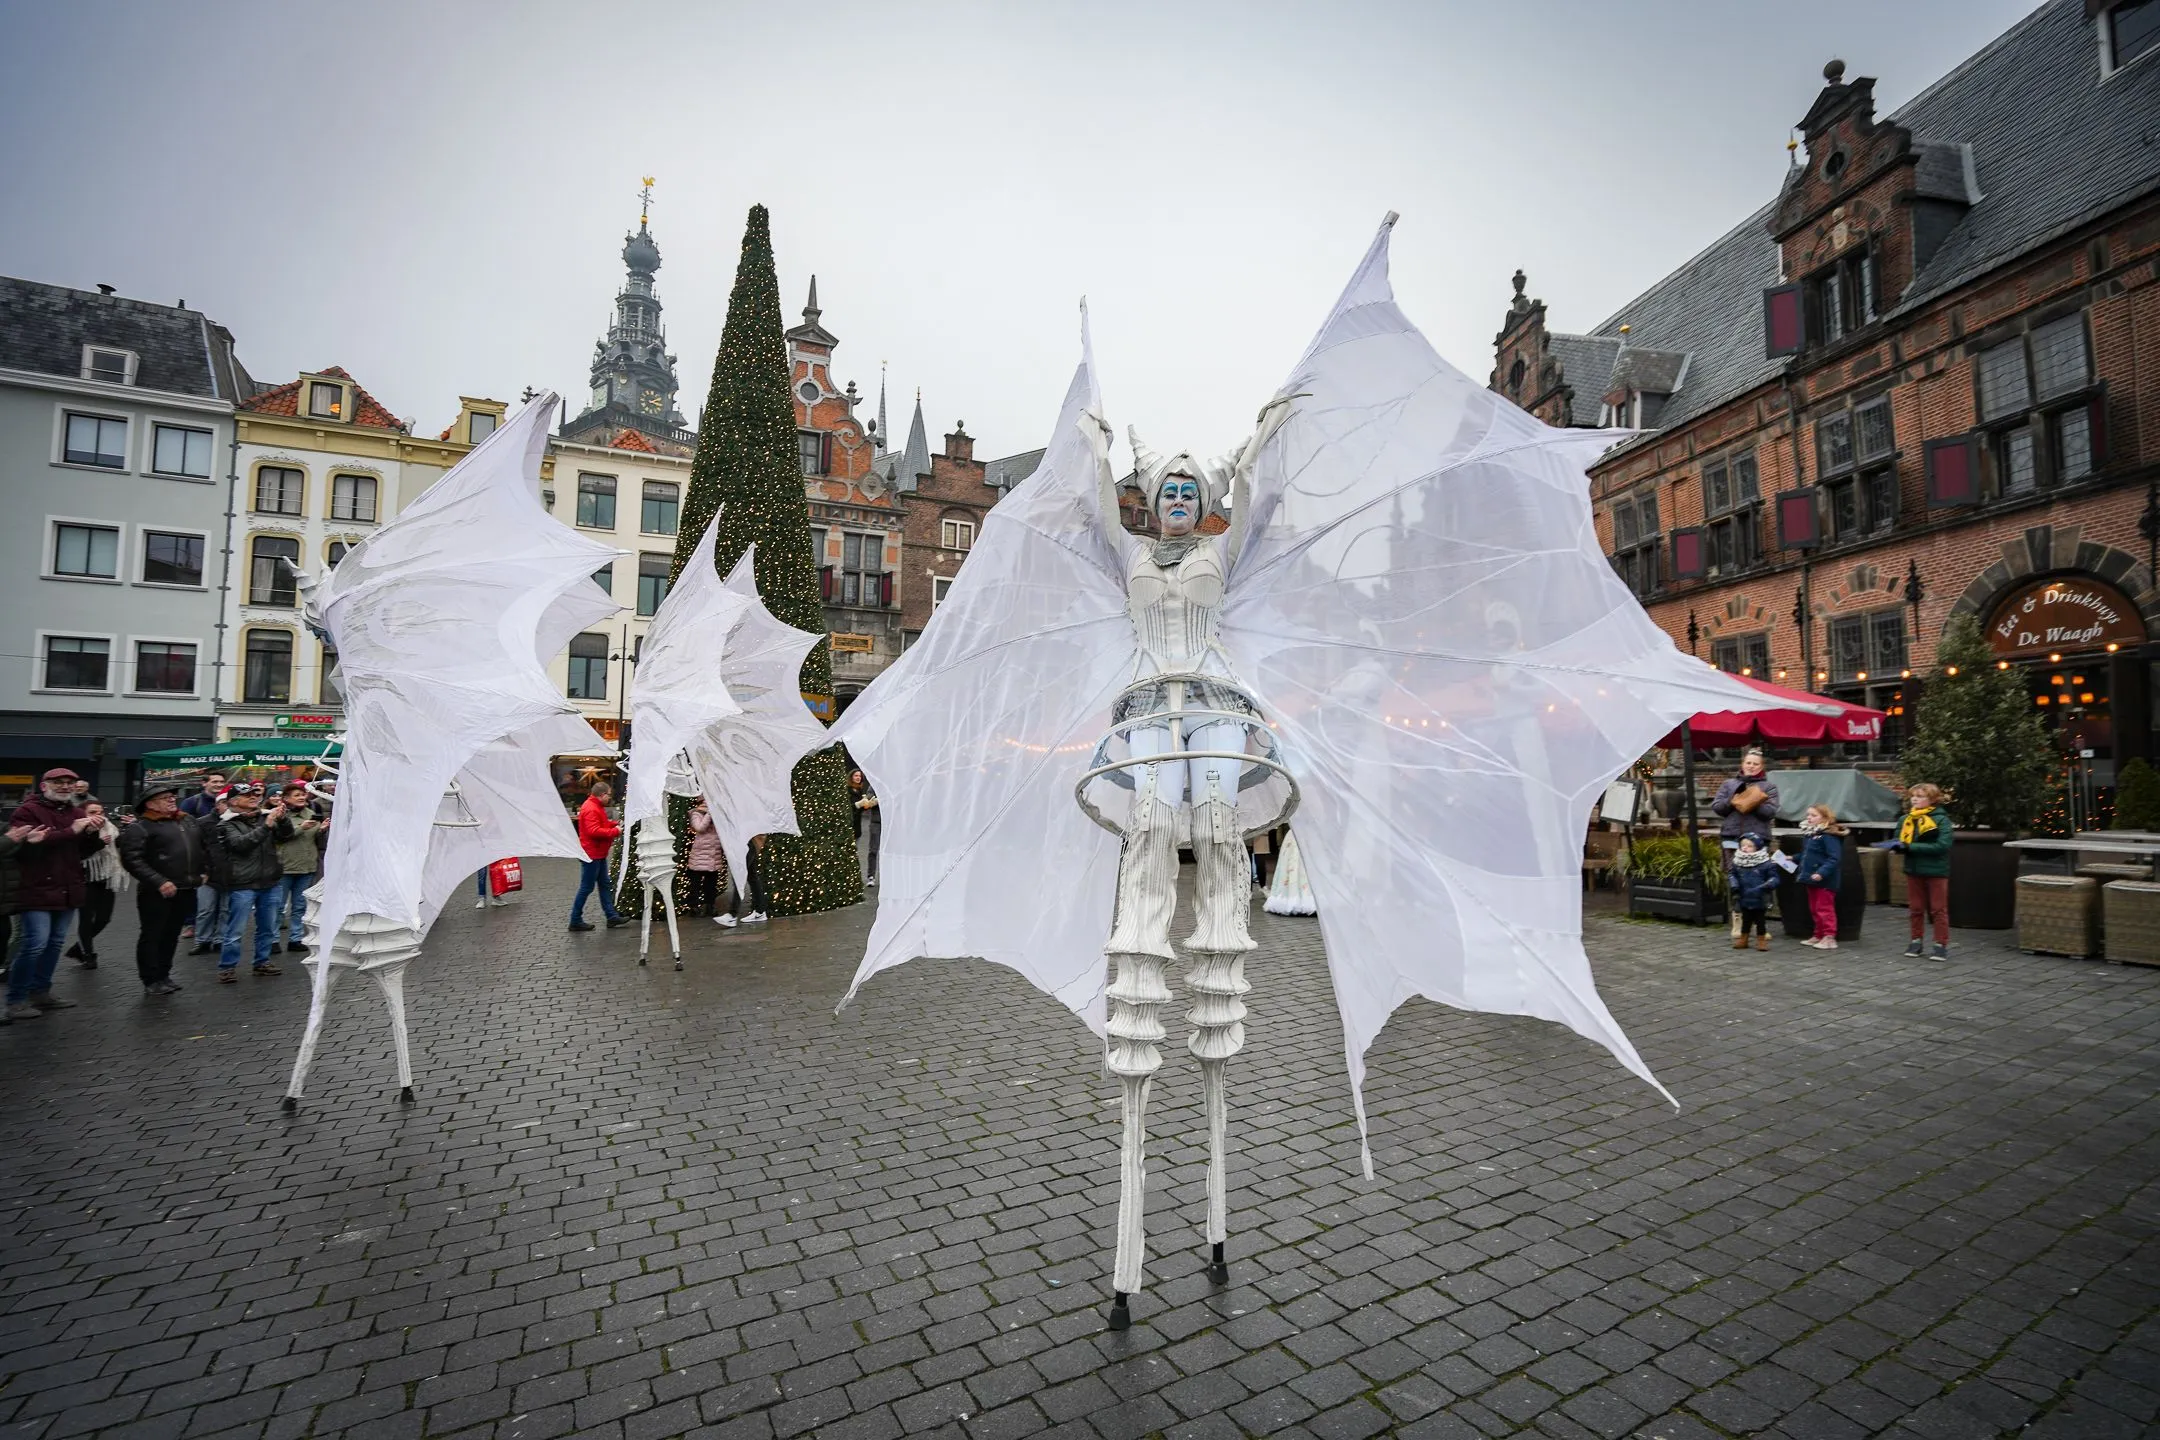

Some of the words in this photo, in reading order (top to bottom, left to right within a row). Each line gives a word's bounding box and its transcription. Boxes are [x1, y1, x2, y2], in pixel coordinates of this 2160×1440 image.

[1996, 614, 2019, 638] Eet
[2022, 597, 2037, 613] &
[2043, 589, 2121, 625] Drinkhuys
[2017, 631, 2041, 647] De
[2046, 621, 2104, 643] Waagh
[209, 754, 245, 762] FALAFEL
